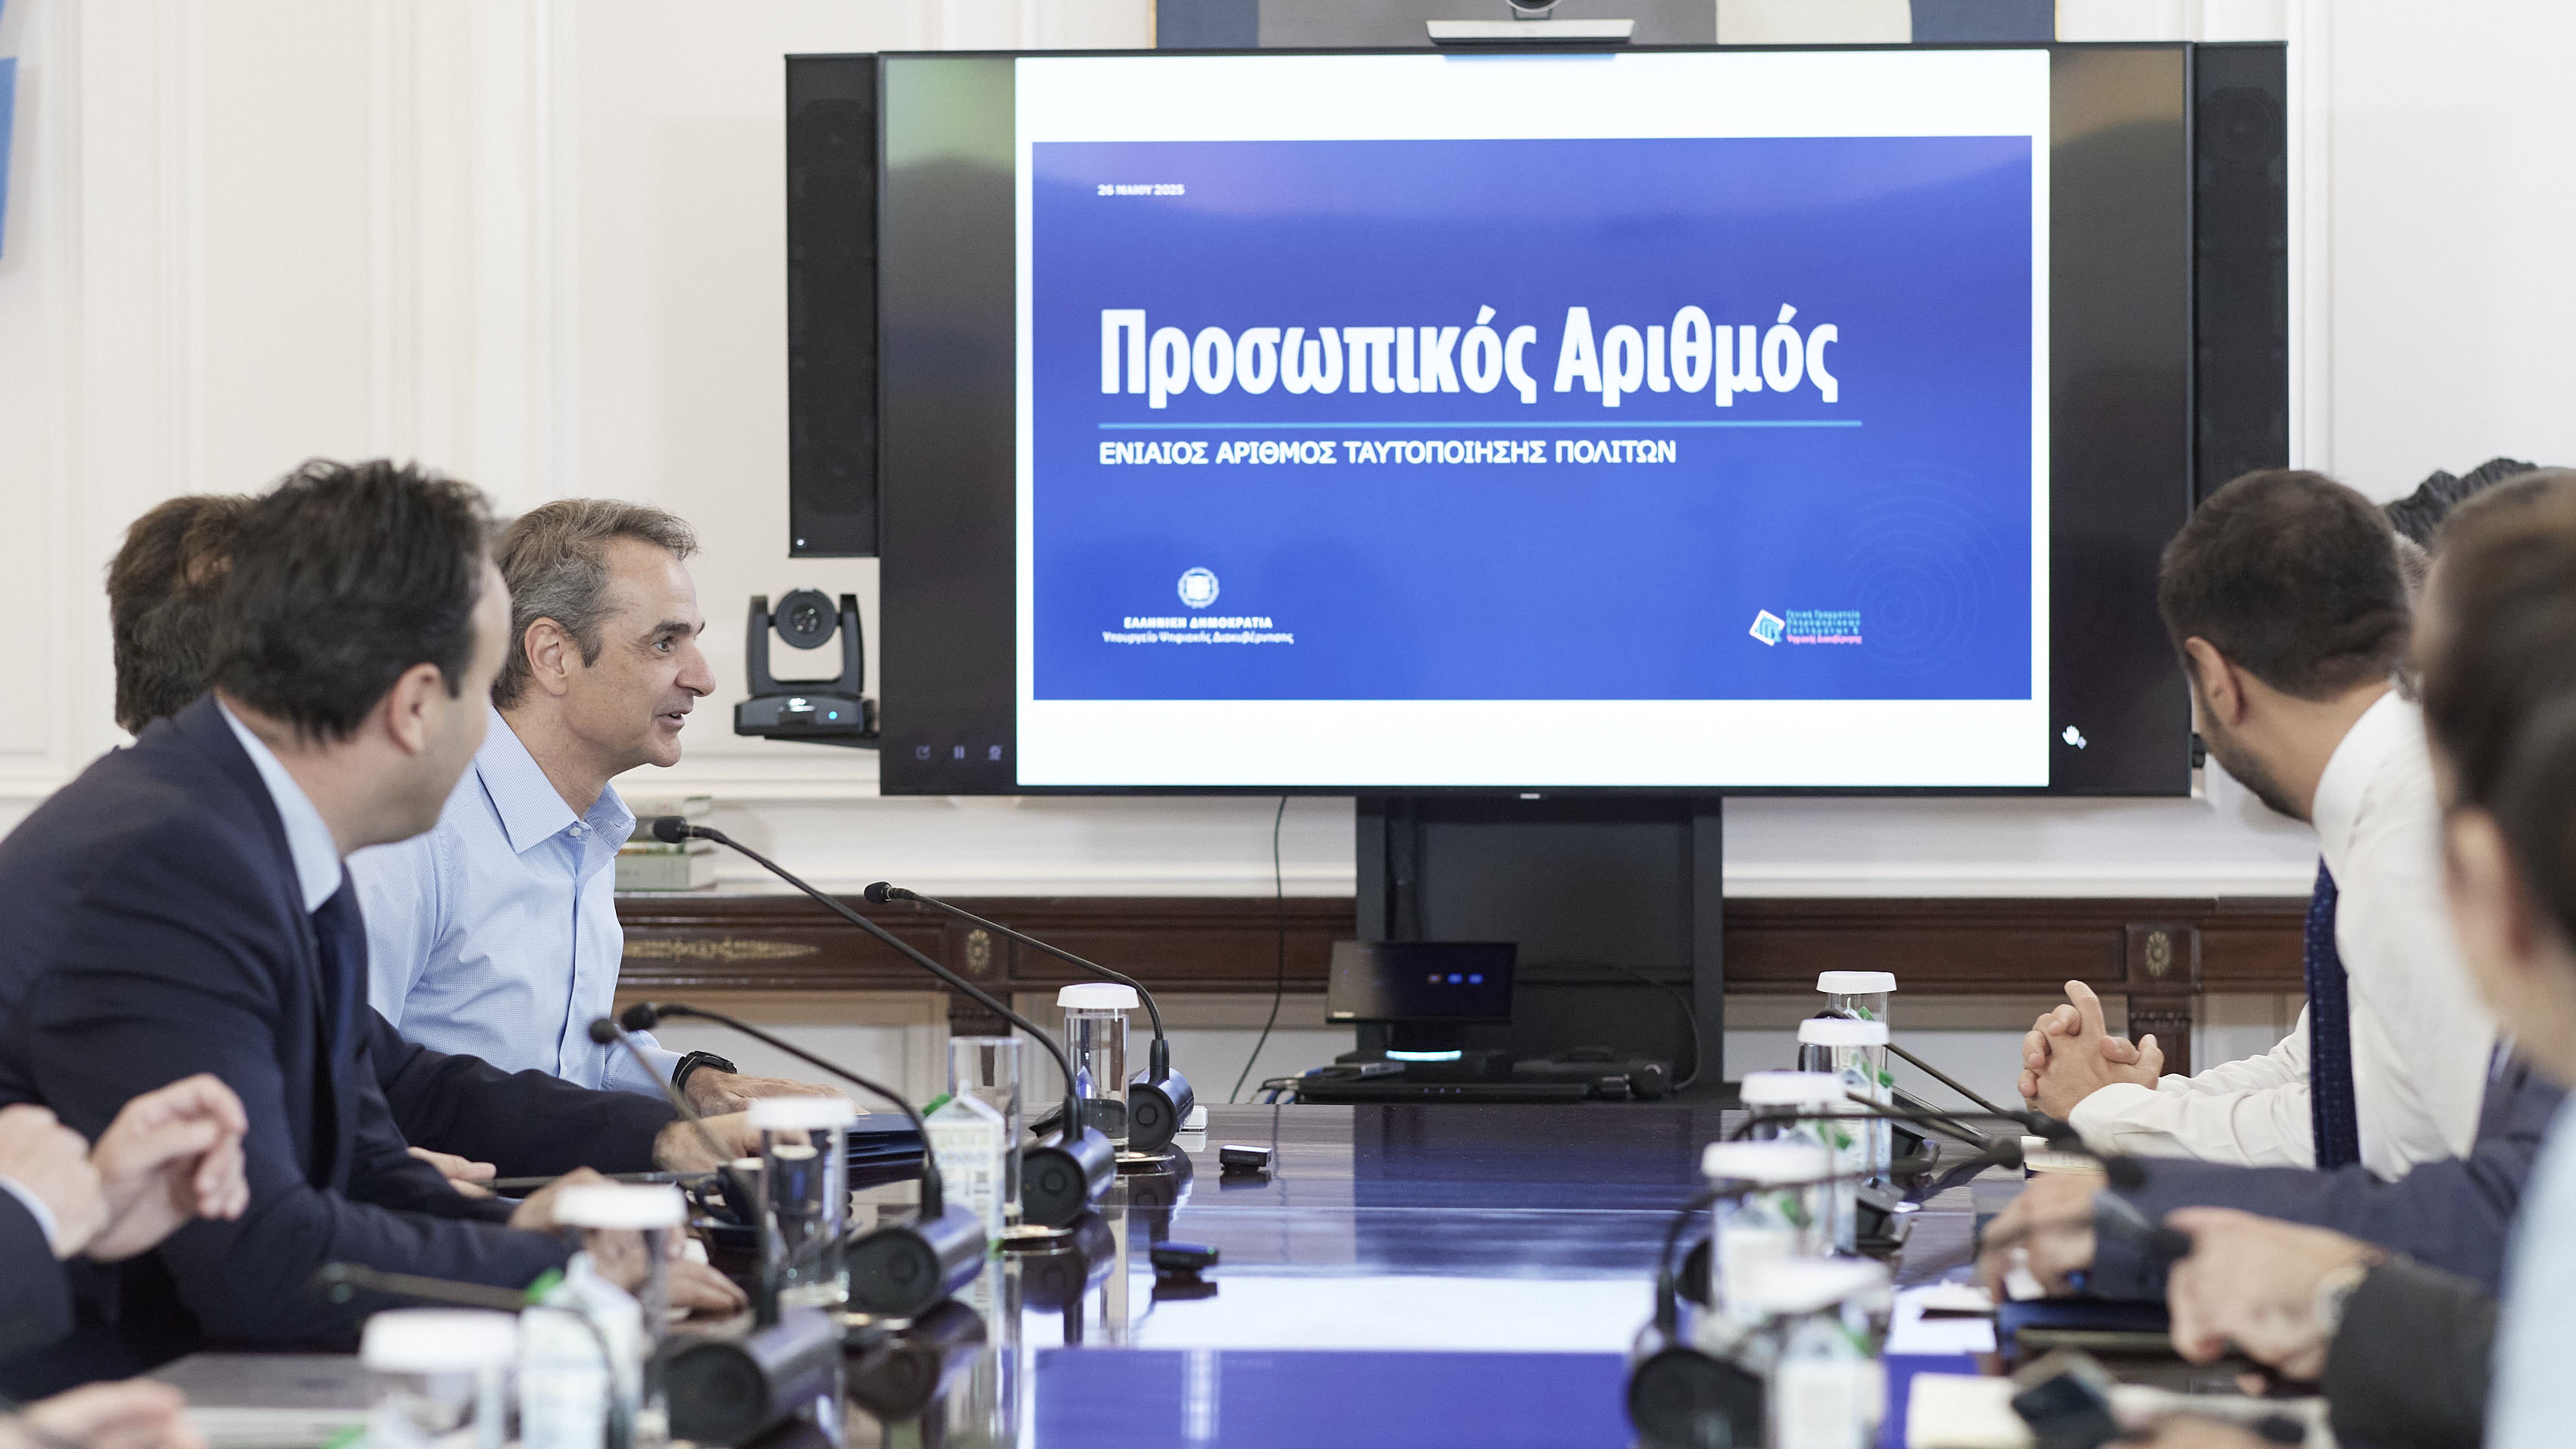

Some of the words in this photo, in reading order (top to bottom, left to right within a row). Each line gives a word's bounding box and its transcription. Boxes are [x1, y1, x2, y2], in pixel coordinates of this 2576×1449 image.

[1097, 183, 1114, 196] 26
[1153, 183, 1185, 196] 2025
[1100, 305, 1537, 409] Προσωπικός
[1553, 303, 1838, 408] Αριθμός
[1099, 441, 1209, 465] ΕΝΙΑΙΟΣ
[1215, 440, 1337, 465] ΑΡΙΘΜΟΣ
[1343, 440, 1547, 464] ΤΑΥΤΟΠΟΙΗΣΗΣ
[1555, 440, 1676, 464] ΠΟΛΙΤΩΝ
[1124, 616, 1187, 629] ΕΛΛΗΝΙΚΗ
[1189, 616, 1274, 629] ΔΗΜΟΚΡΑΤΙΑ
